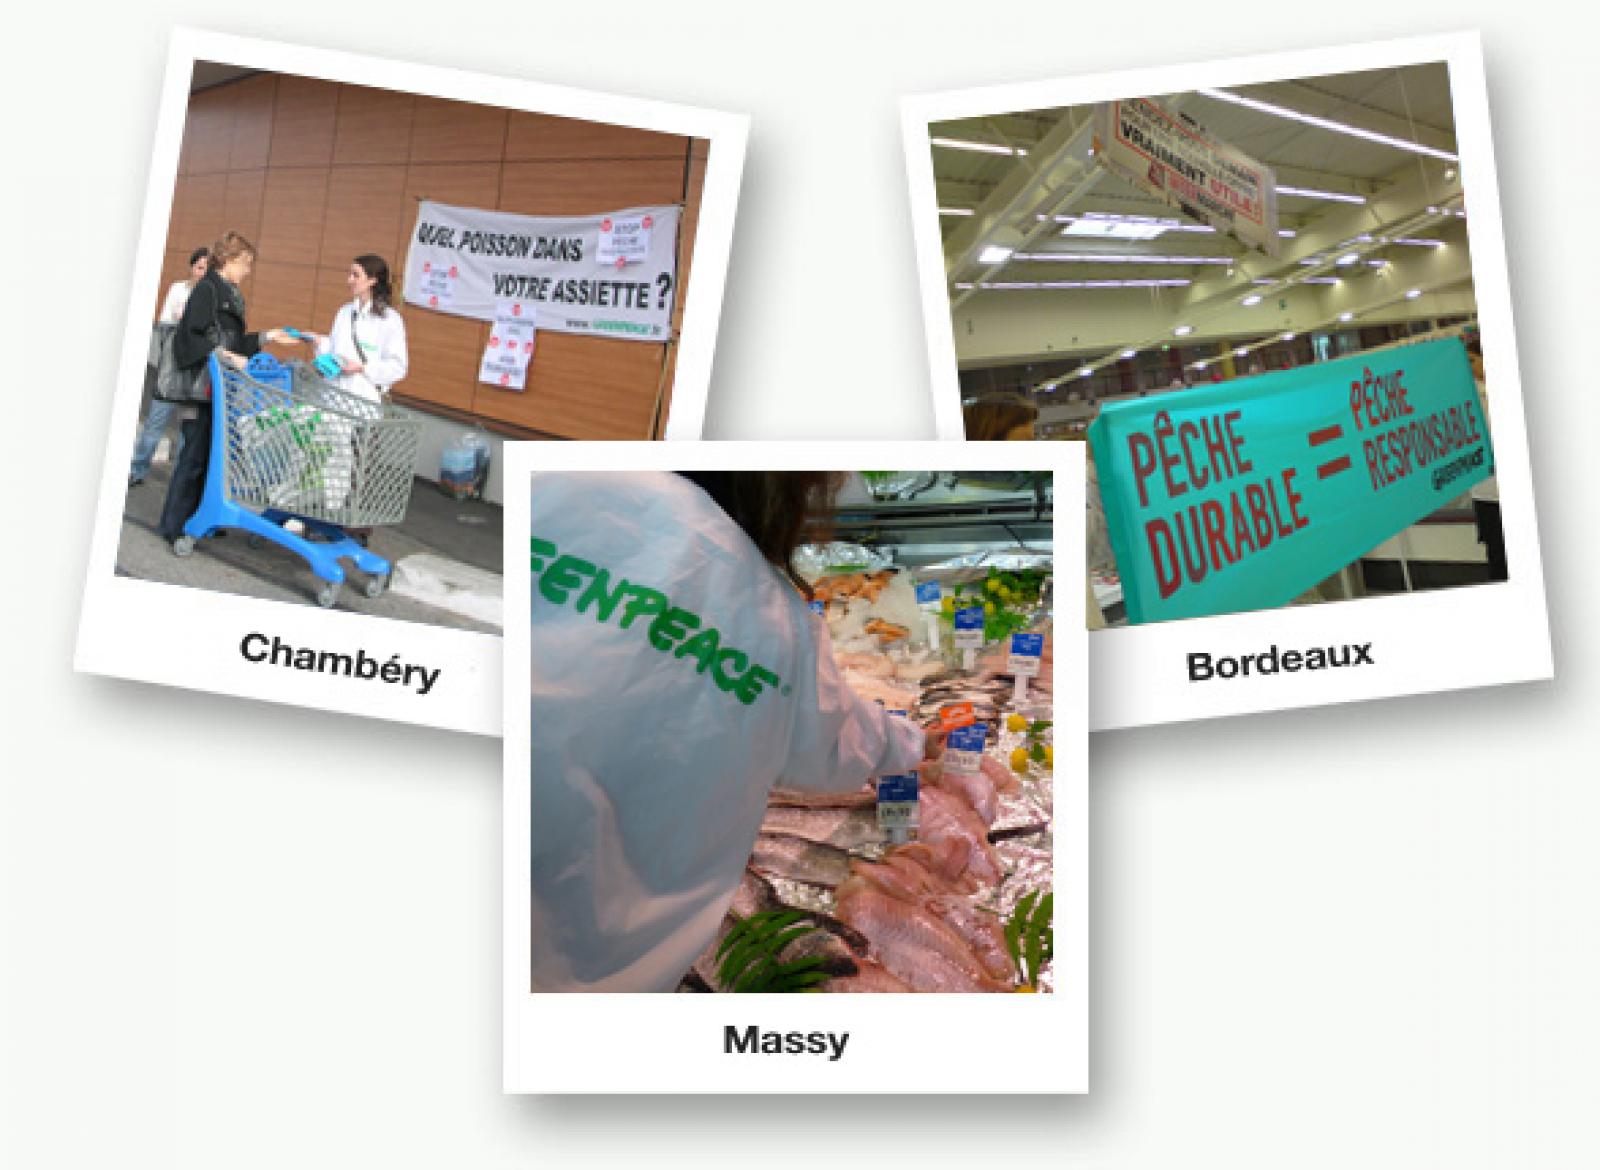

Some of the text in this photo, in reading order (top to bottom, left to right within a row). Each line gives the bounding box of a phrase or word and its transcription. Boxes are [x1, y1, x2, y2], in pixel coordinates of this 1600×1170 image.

[418, 220, 583, 262] QUEL POISSON DANS
[493, 271, 672, 310] VOTRE ASSIETTE ?
[1349, 367, 1414, 432] PÊCHE
[1127, 410, 1253, 508] PÊCHE
[1362, 401, 1482, 491] RESPONSABLE
[1145, 467, 1310, 600] DURABLE
